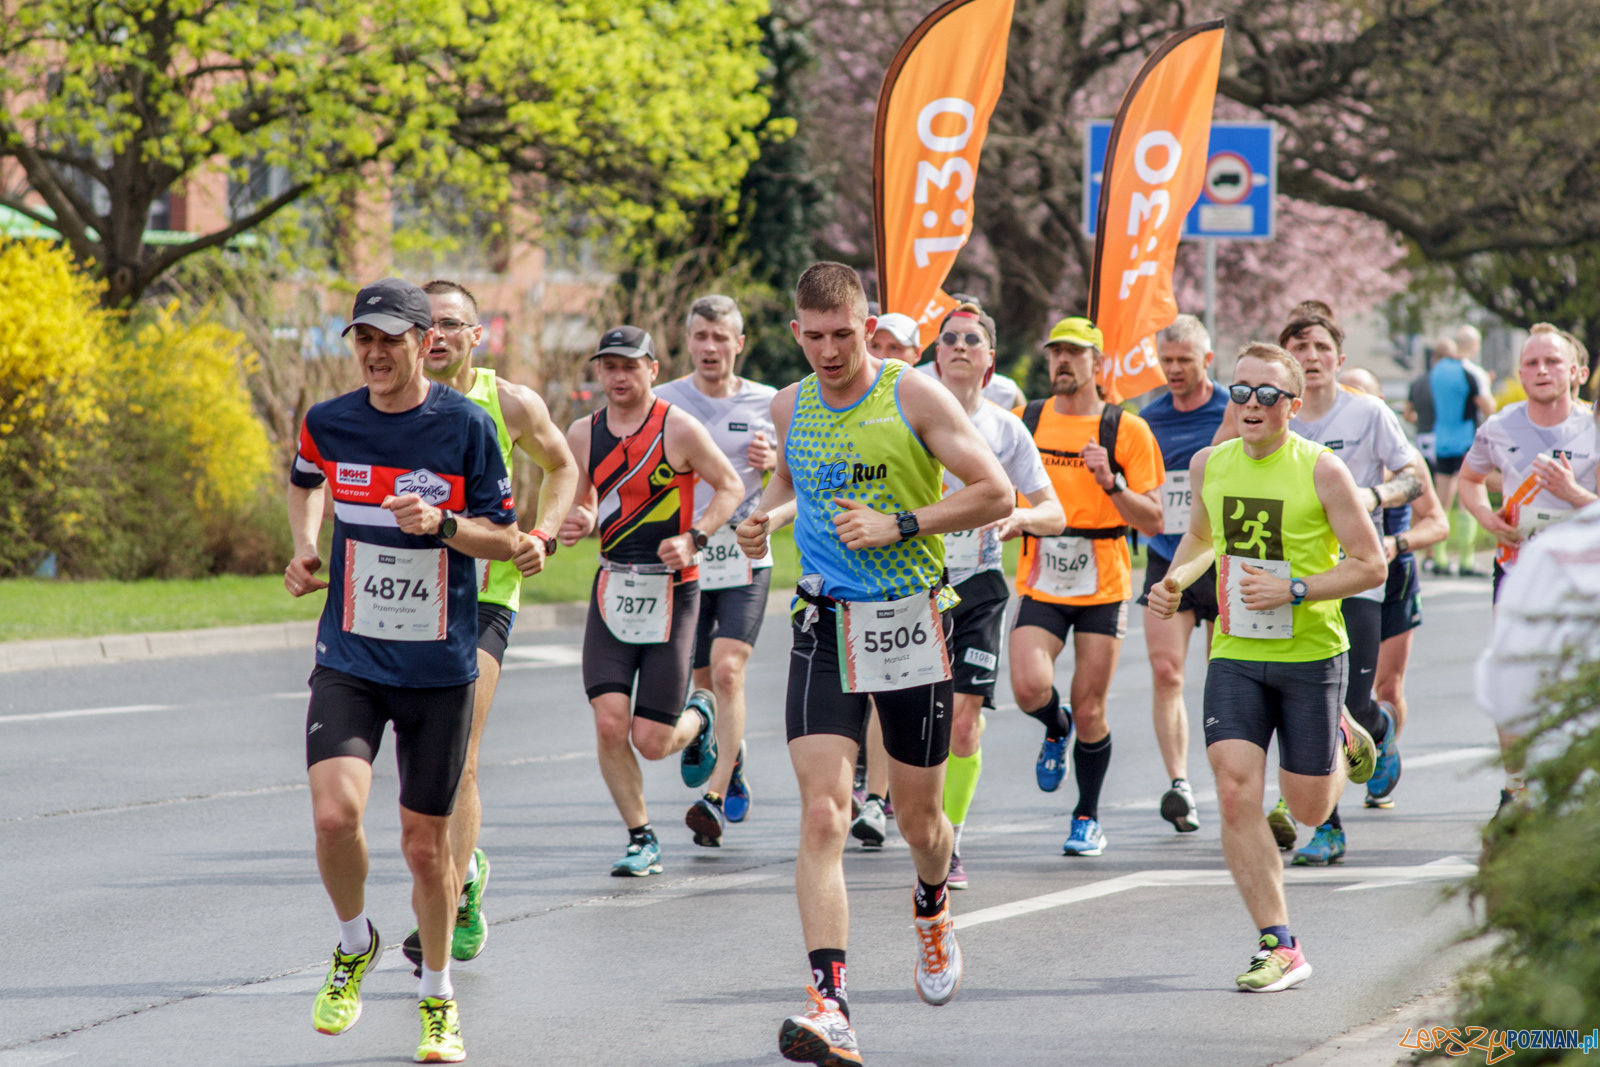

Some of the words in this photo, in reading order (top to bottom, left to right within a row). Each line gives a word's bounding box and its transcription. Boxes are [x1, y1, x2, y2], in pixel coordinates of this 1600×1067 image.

[914, 97, 975, 269] 1:30
[1119, 130, 1182, 300] 1:30
[1041, 457, 1085, 469] EMAKER
[816, 460, 848, 492] ZG
[852, 462, 888, 484] Run
[336, 488, 370, 497] FACTORY
[1045, 552, 1088, 573] 11549
[364, 575, 429, 602] 4874
[616, 595, 657, 614] 7877
[864, 622, 927, 653] 5506
[884, 655, 910, 665] Mariusz
